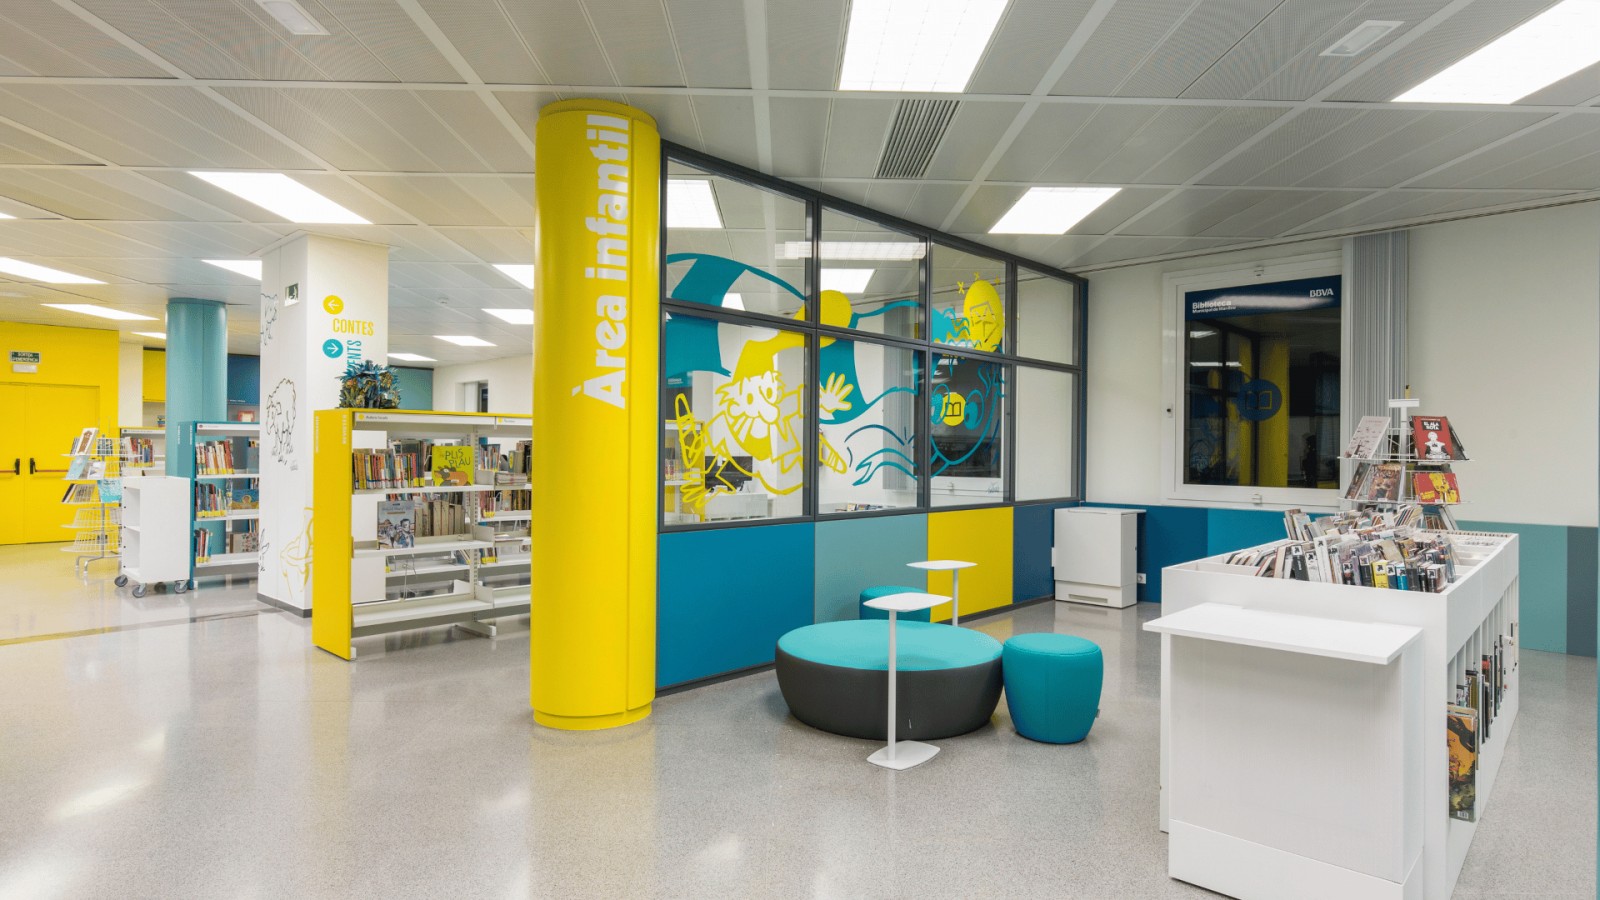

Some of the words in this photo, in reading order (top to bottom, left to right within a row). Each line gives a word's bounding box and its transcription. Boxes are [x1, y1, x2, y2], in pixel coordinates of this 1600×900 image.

[585, 114, 629, 281] infantil
[1309, 288, 1334, 298] BBVA
[1192, 300, 1232, 310] Biblioteca
[332, 318, 374, 336] CONTES
[572, 294, 627, 410] Àrea
[448, 457, 471, 468] PLAU
